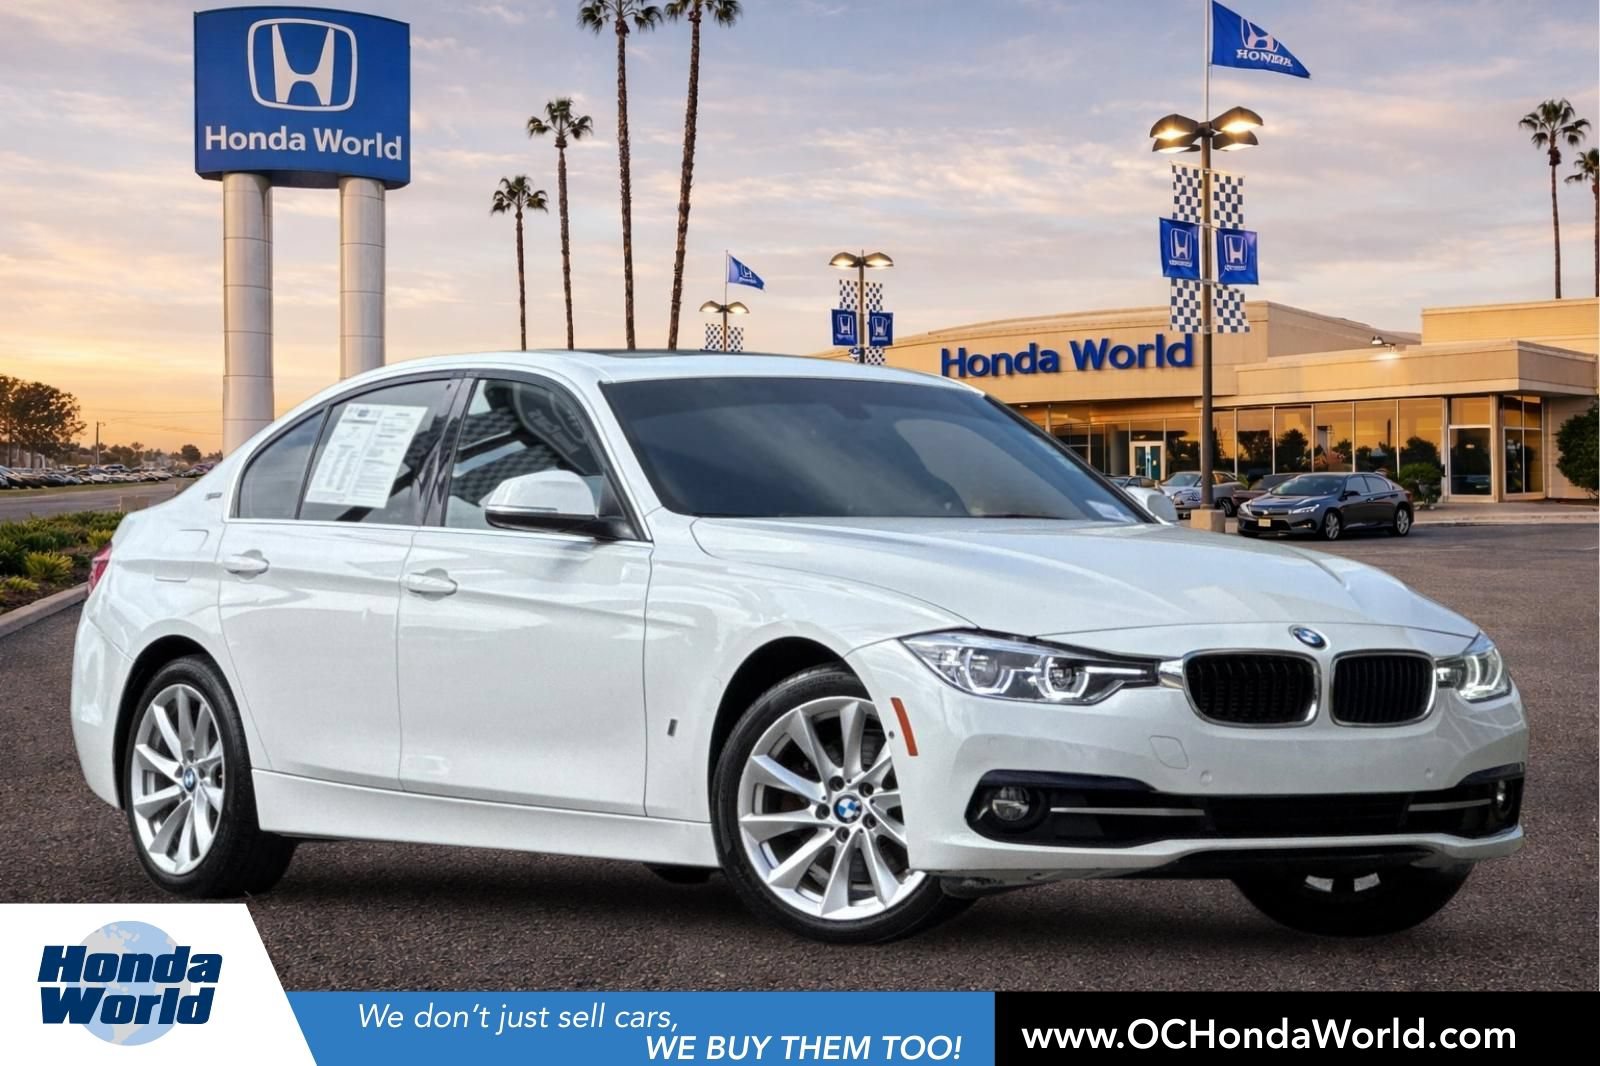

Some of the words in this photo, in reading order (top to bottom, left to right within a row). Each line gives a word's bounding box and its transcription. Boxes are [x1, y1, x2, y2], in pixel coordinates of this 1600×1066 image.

[205, 125, 305, 151] Honda
[313, 128, 402, 161] World
[941, 342, 1061, 378] Honda
[1070, 333, 1194, 371] World
